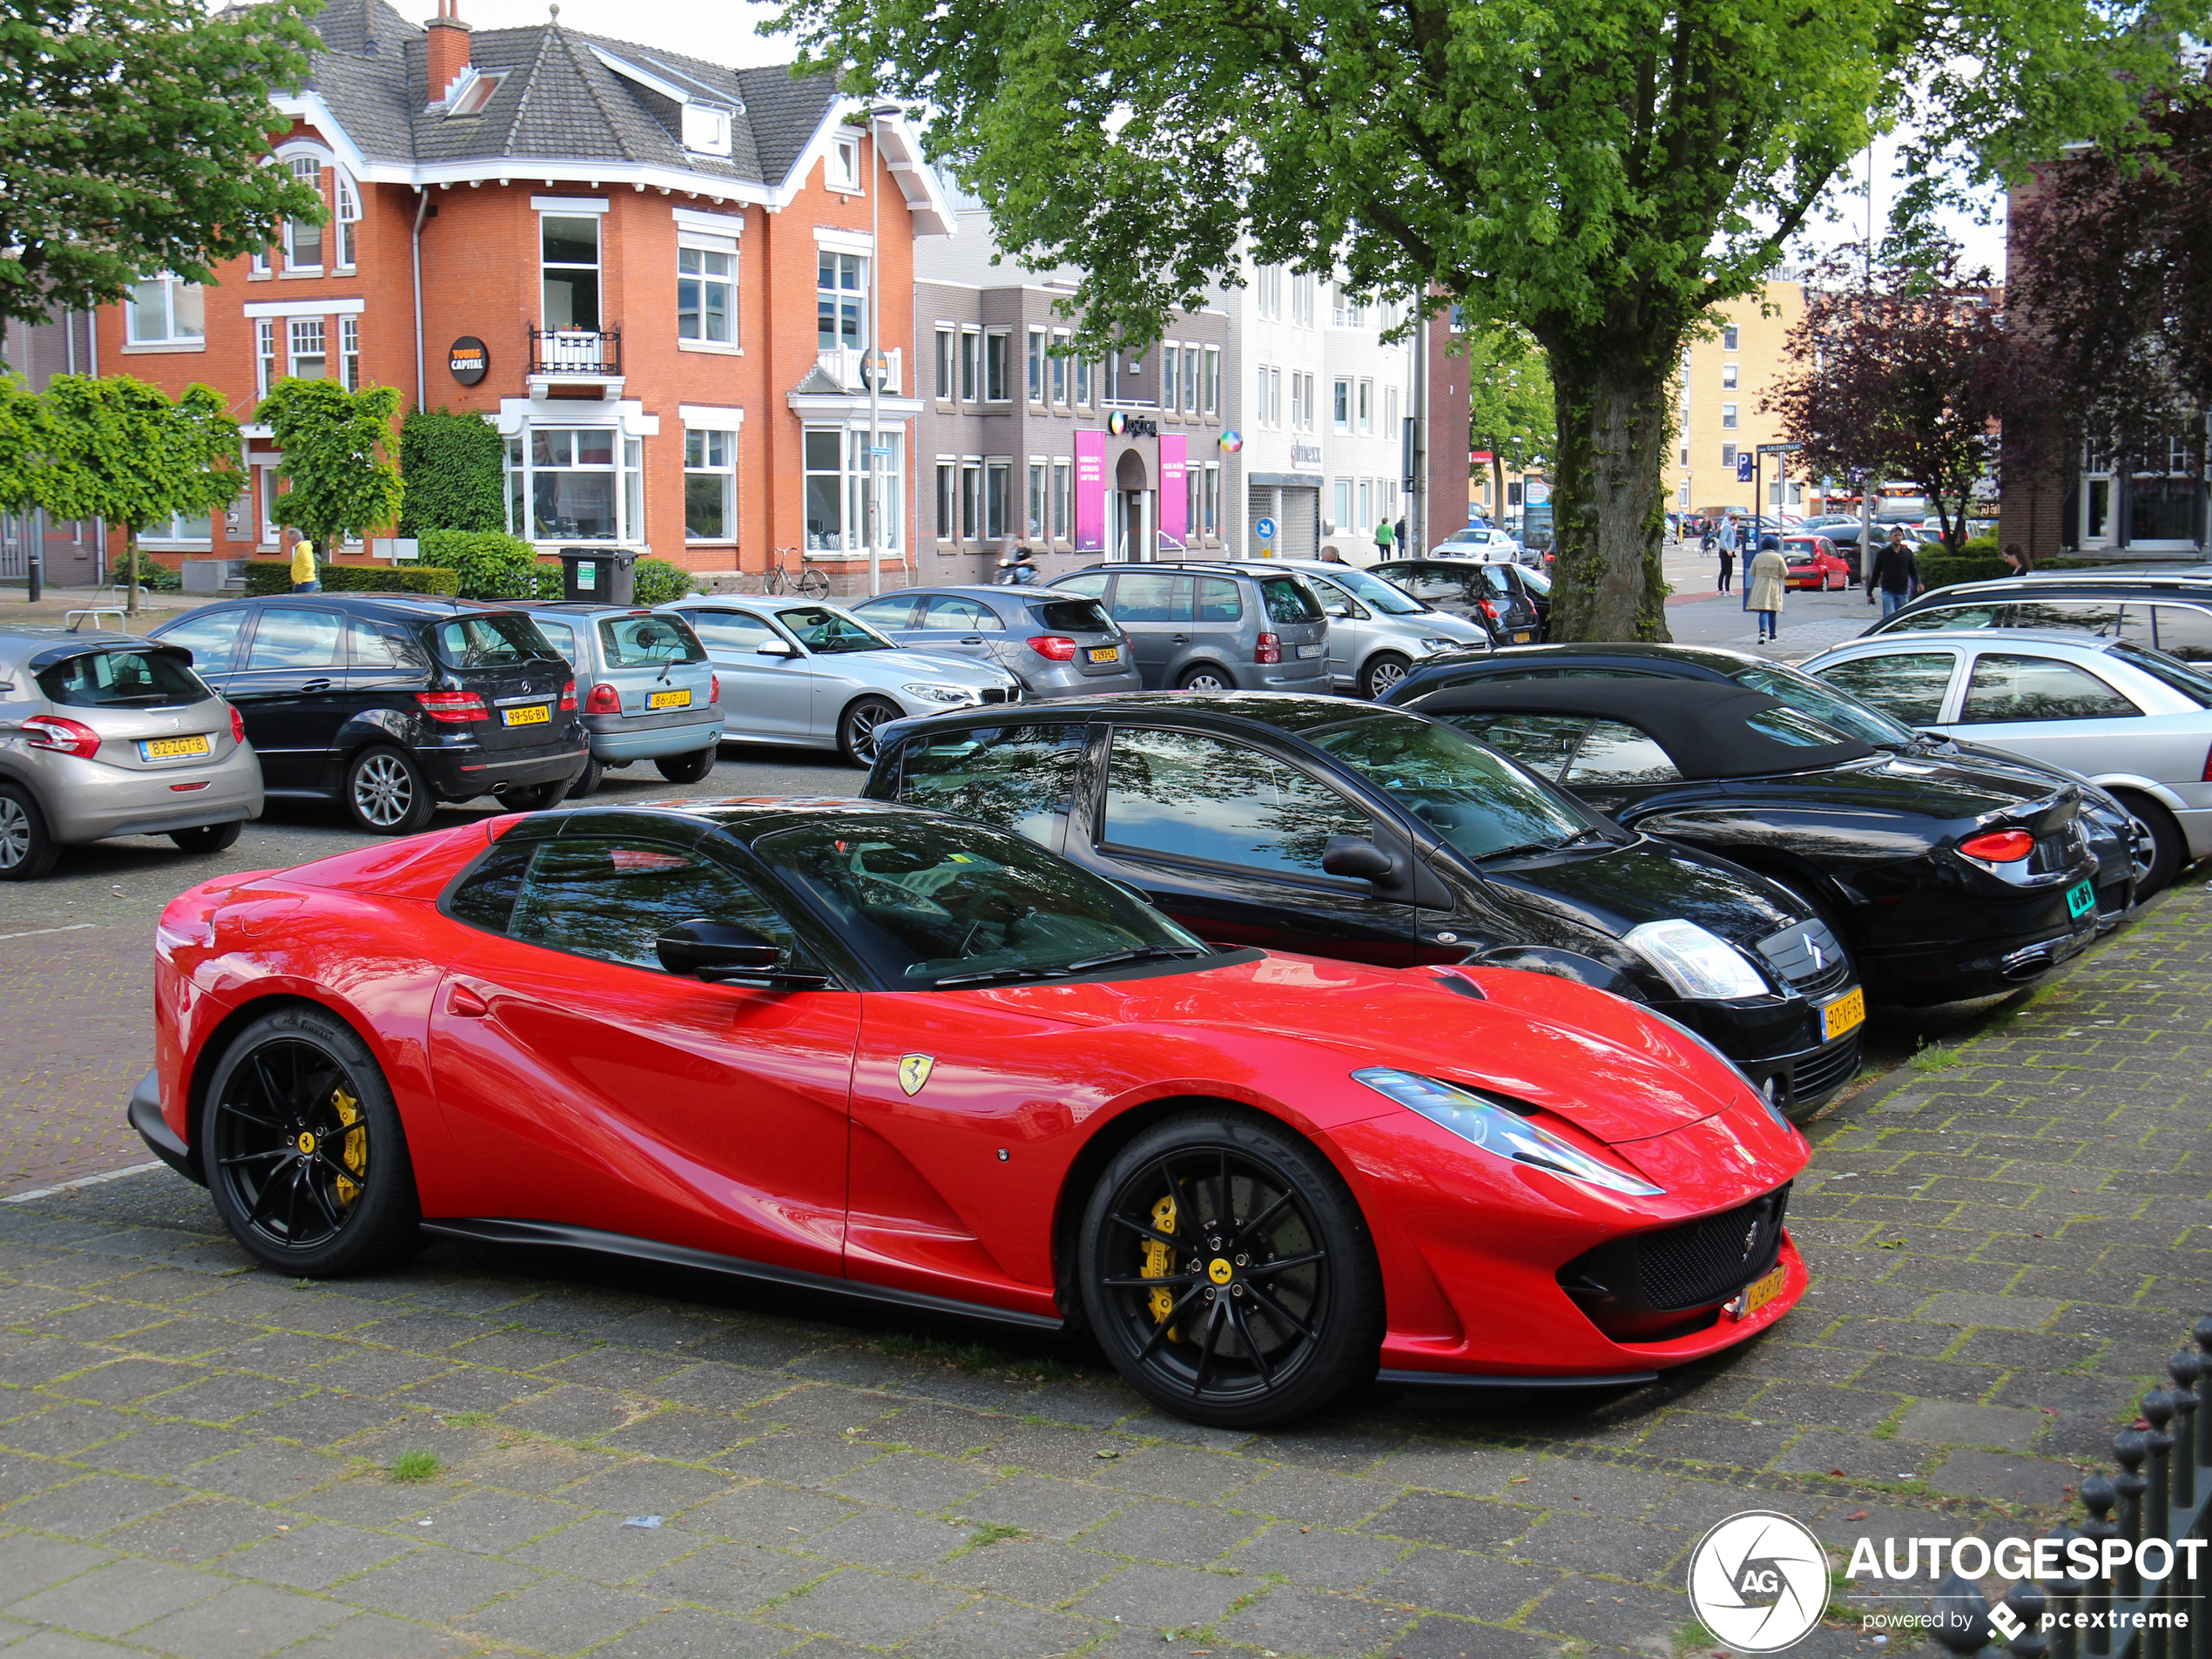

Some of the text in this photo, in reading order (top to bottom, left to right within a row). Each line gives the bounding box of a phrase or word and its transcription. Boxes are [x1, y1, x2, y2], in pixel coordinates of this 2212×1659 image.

[452, 348, 481, 359] YOUNG
[451, 358, 483, 370] CAPITAL
[1739, 454, 1748, 470] P
[1749, 528, 1755, 538] P
[1093, 649, 1116, 660] J-293-LZ
[655, 692, 687, 706] 86-JZ-JJ
[509, 708, 546, 724] 99-SG-BV
[152, 738, 204, 755] 82-ZGT-8
[1826, 994, 1862, 1034] 90-XF-BS
[1745, 1271, 1783, 1312] K-249-TR
